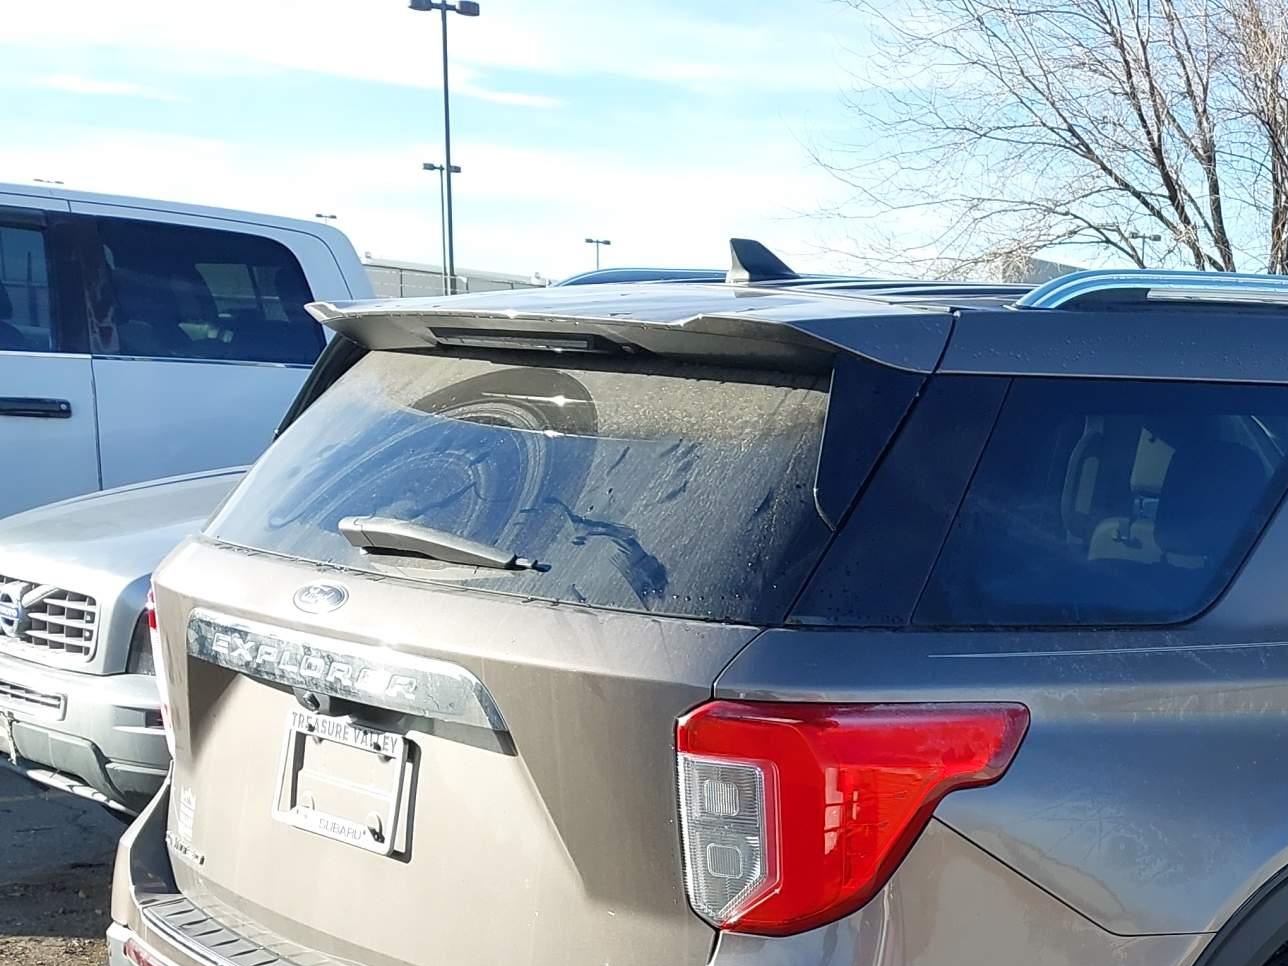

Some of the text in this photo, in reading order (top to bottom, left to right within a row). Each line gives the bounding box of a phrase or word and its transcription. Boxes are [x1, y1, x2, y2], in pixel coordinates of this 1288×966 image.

[211, 632, 417, 699] EXPLORER
[292, 711, 349, 741] TREASURE
[318, 818, 362, 840] SUBARU
